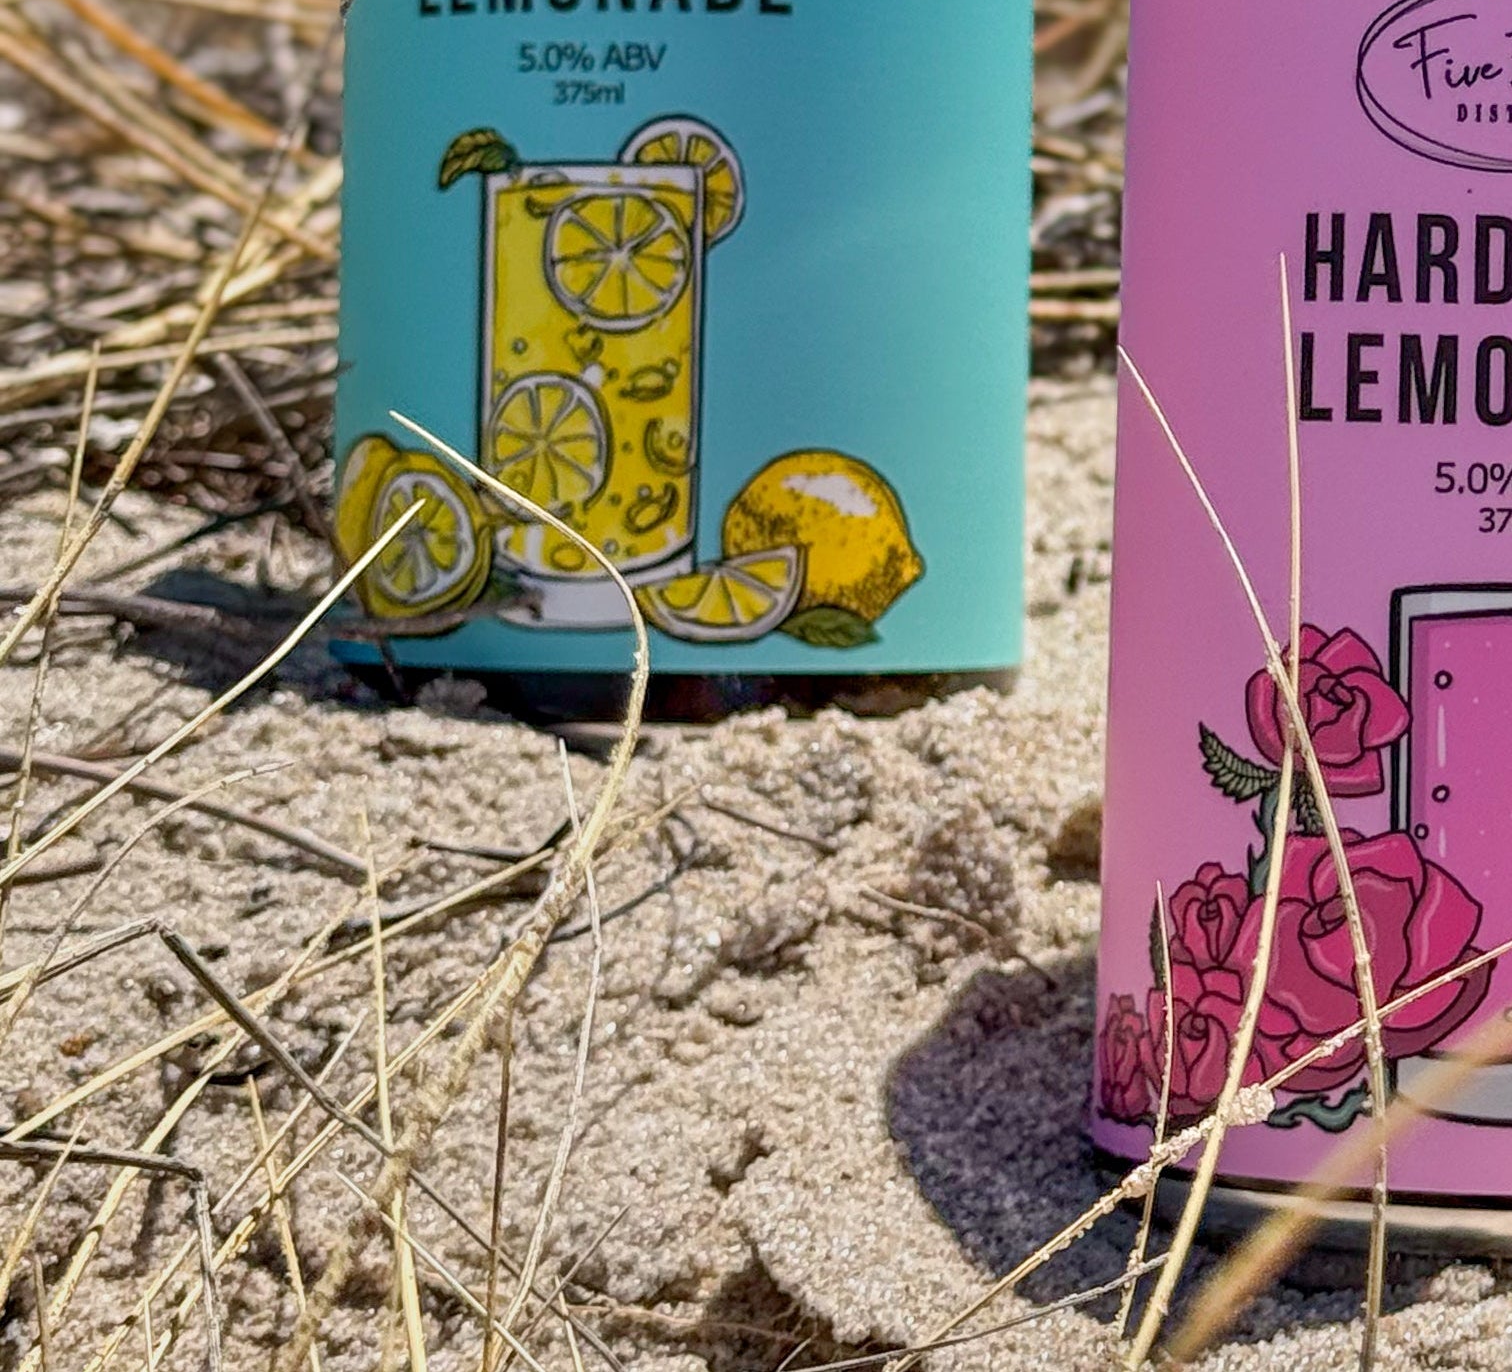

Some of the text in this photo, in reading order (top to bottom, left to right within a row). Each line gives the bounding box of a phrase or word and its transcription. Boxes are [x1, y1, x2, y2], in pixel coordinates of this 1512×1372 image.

[517, 43, 667, 73] 5.0% ABV
[1392, 14, 1502, 99] Five
[552, 80, 625, 105] 375ml
